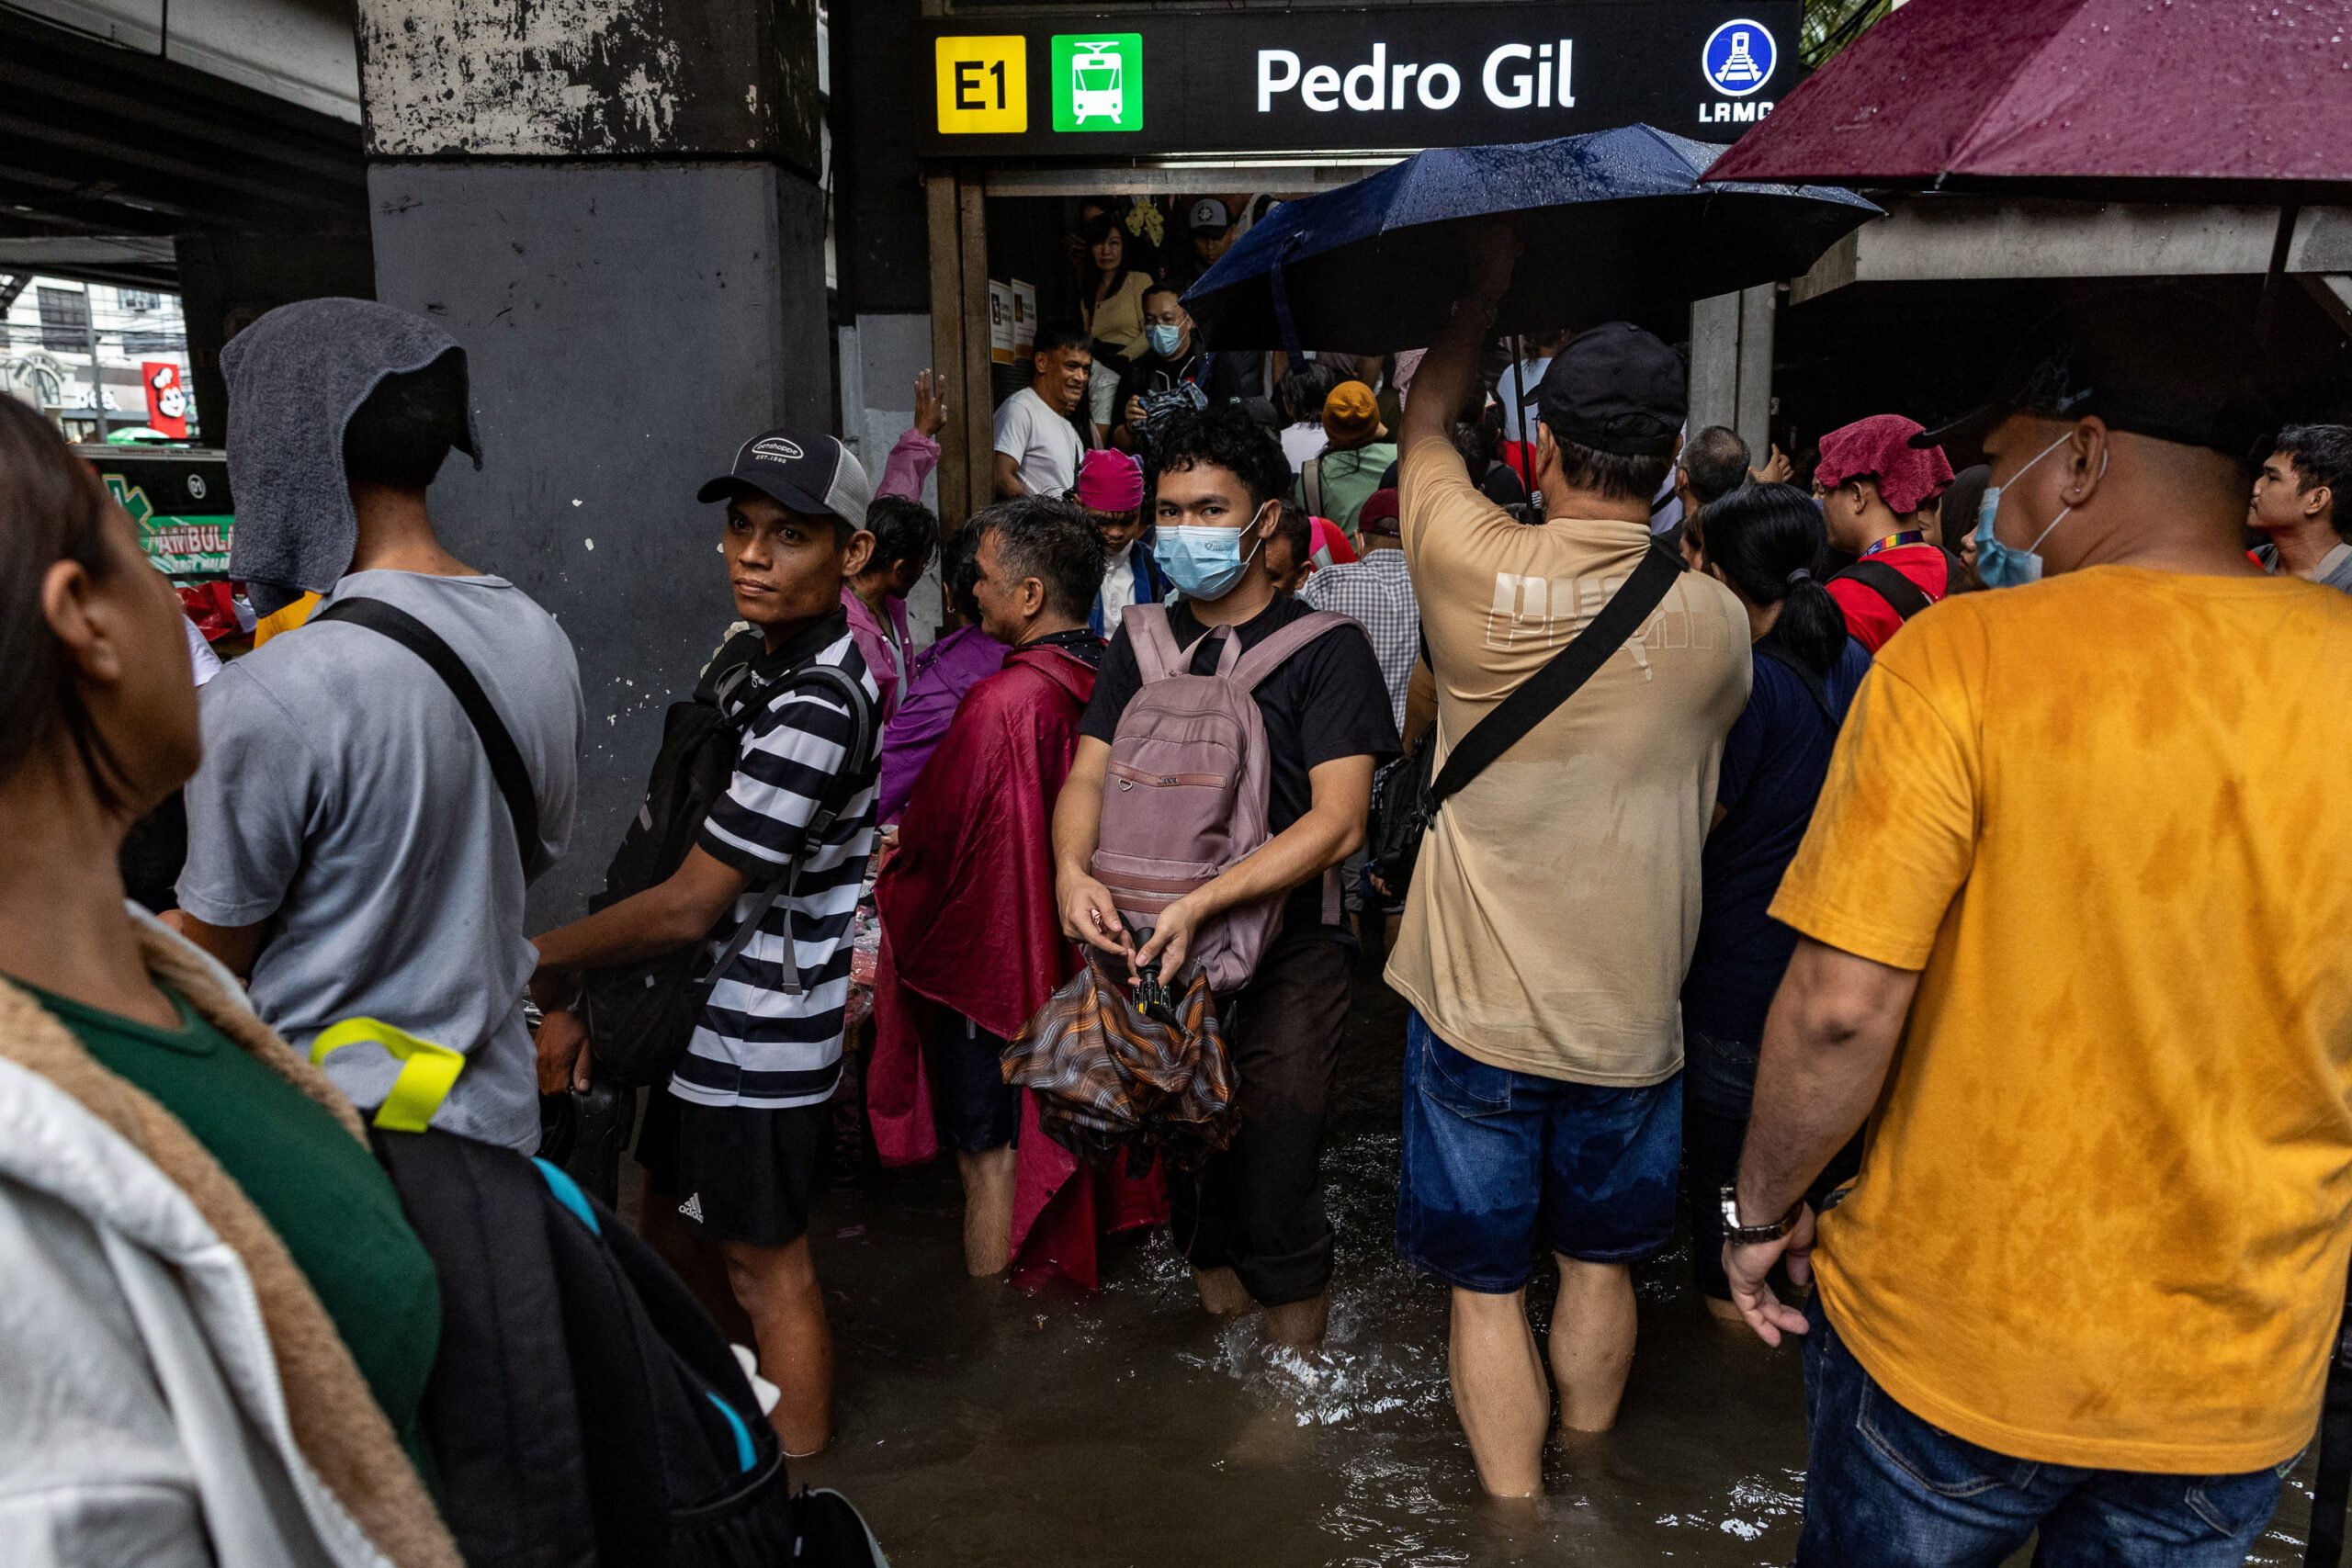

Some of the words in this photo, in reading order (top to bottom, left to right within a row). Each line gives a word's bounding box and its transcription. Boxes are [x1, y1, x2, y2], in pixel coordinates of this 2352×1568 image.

[955, 60, 1006, 110] E1
[1258, 42, 1461, 112] Pedro
[1482, 39, 1576, 109] Gil
[1698, 101, 1775, 123] LRMC
